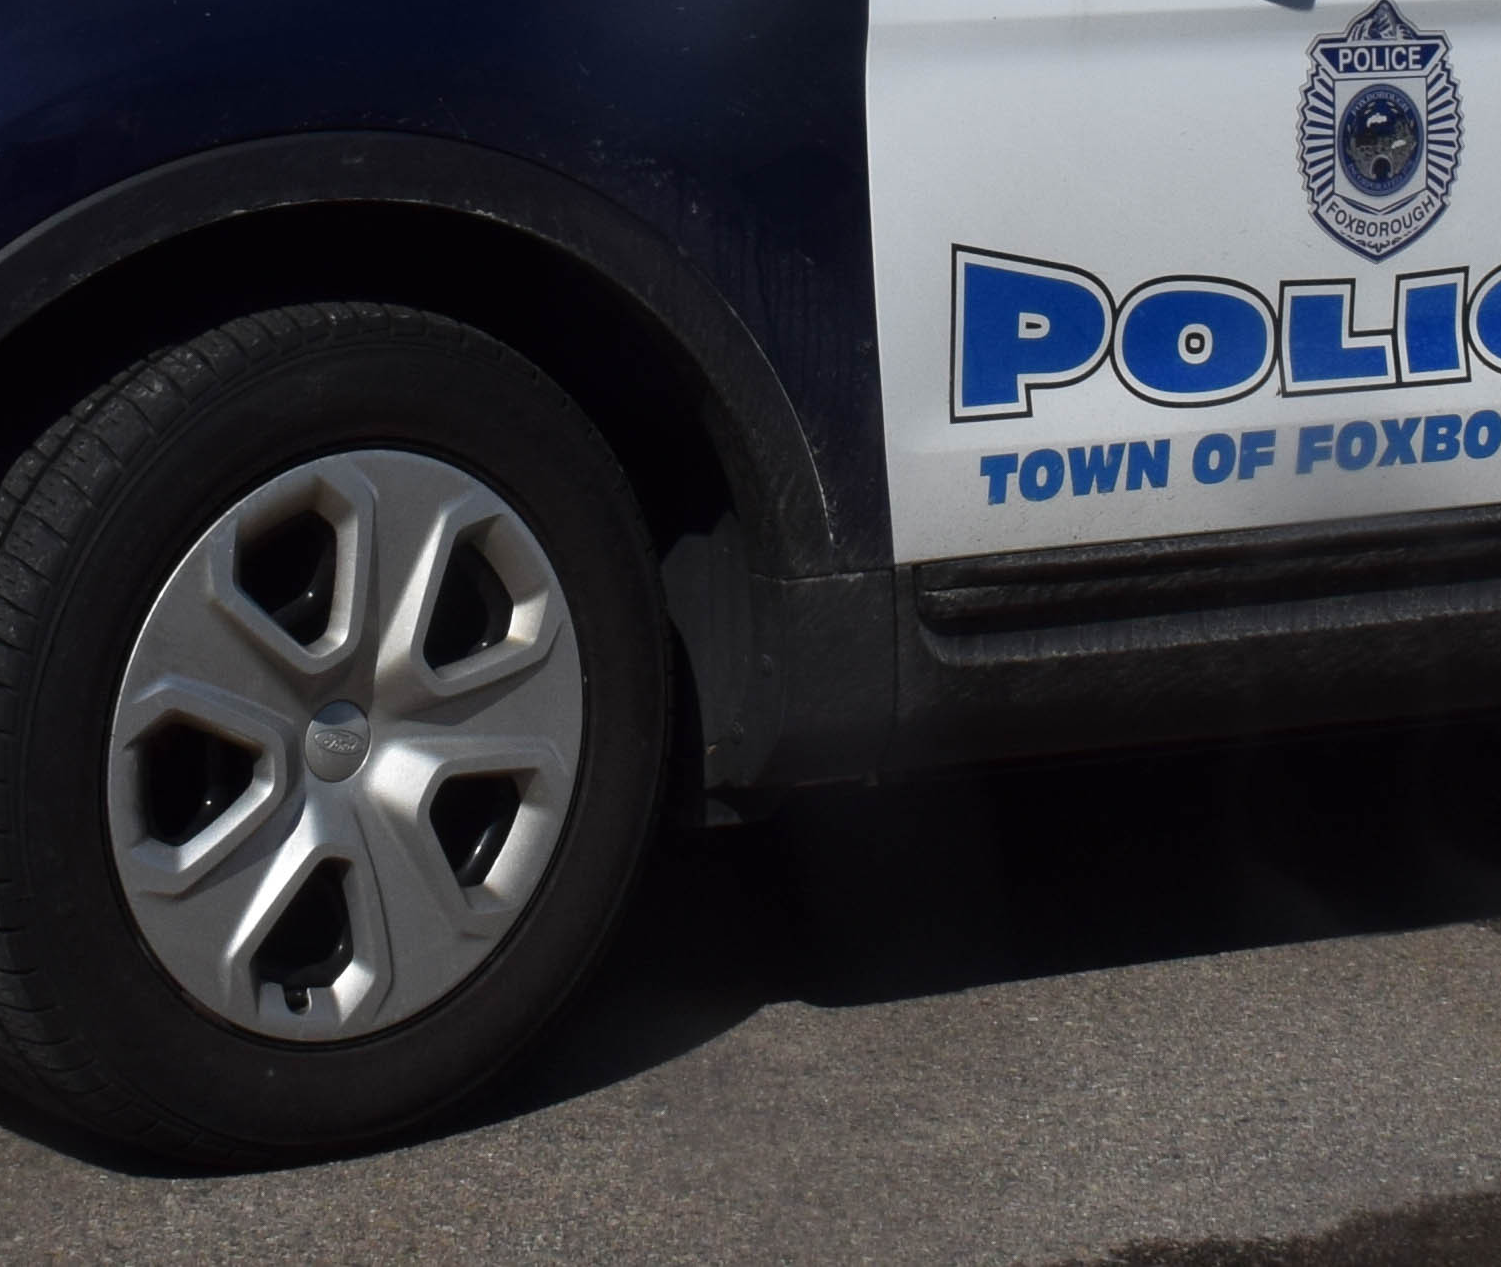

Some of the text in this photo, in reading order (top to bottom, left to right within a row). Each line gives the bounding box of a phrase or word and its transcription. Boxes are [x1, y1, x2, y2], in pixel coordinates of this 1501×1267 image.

[1338, 46, 1422, 72] POLICE
[1326, 195, 1435, 237] FOXBOROUGH
[980, 438, 1171, 506] TOWN
[1192, 429, 1277, 485] OF
